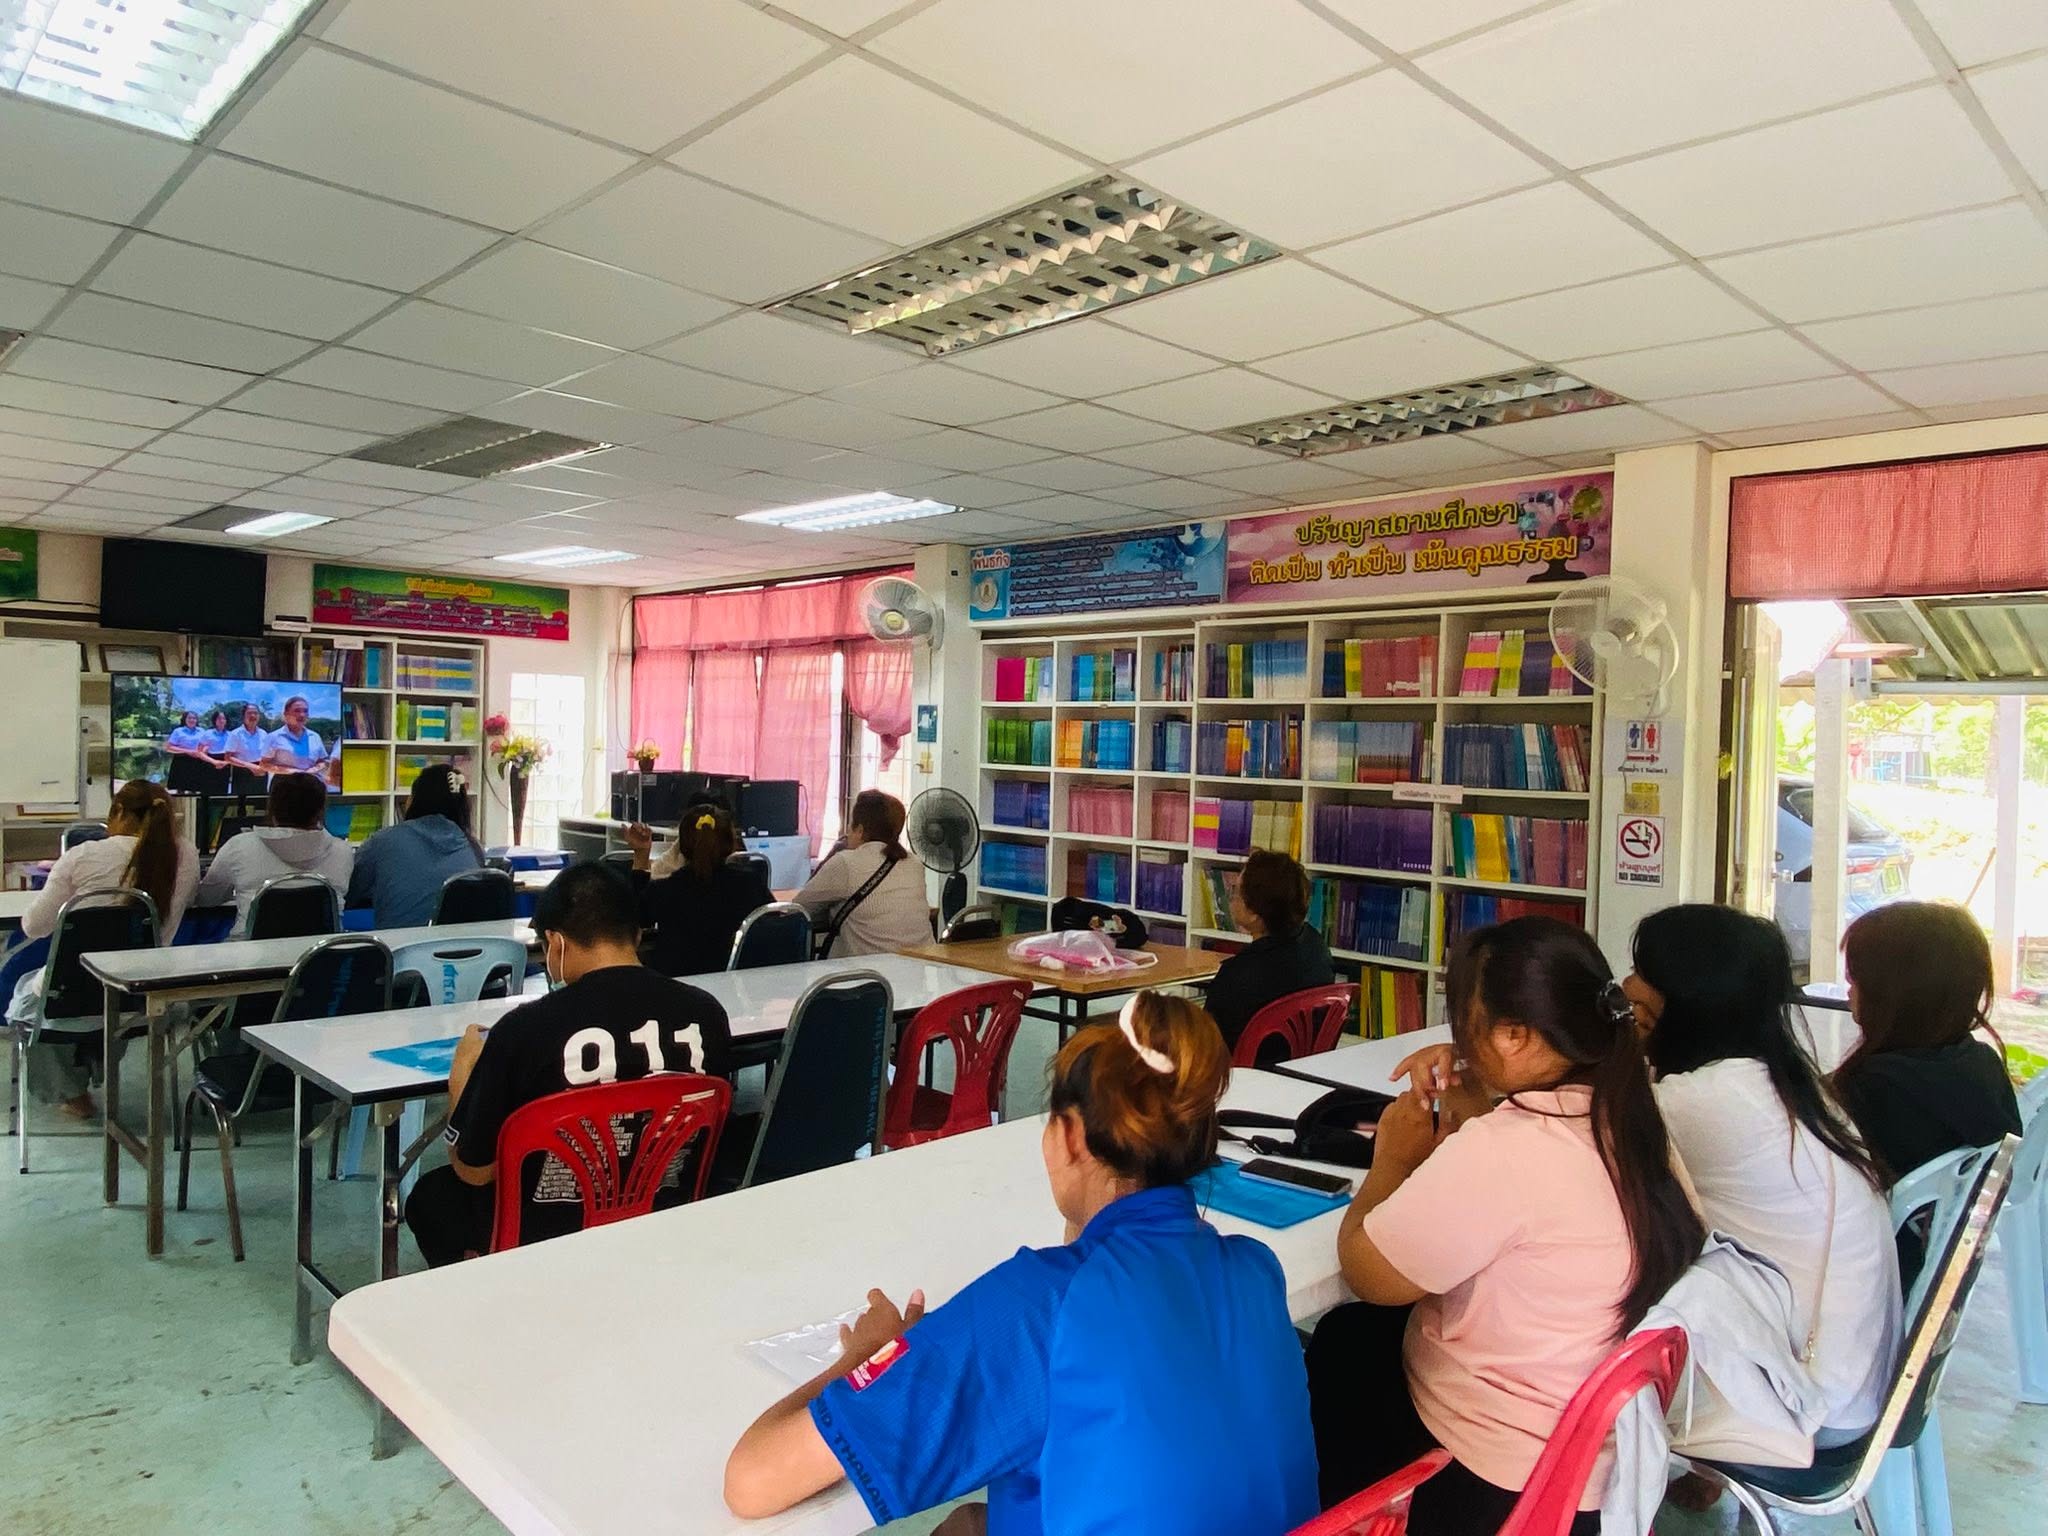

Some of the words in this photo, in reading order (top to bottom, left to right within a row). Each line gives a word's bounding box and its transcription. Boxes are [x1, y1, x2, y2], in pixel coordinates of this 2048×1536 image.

[1296, 499, 1519, 546] ปรัชญาสถานศึกษา
[973, 549, 1010, 569] พันธกิจ
[1250, 553, 1322, 584] คิดเป็น
[1327, 545, 1406, 579] ทำเป็น
[1412, 537, 1579, 576] เน้นคุณธรรม
